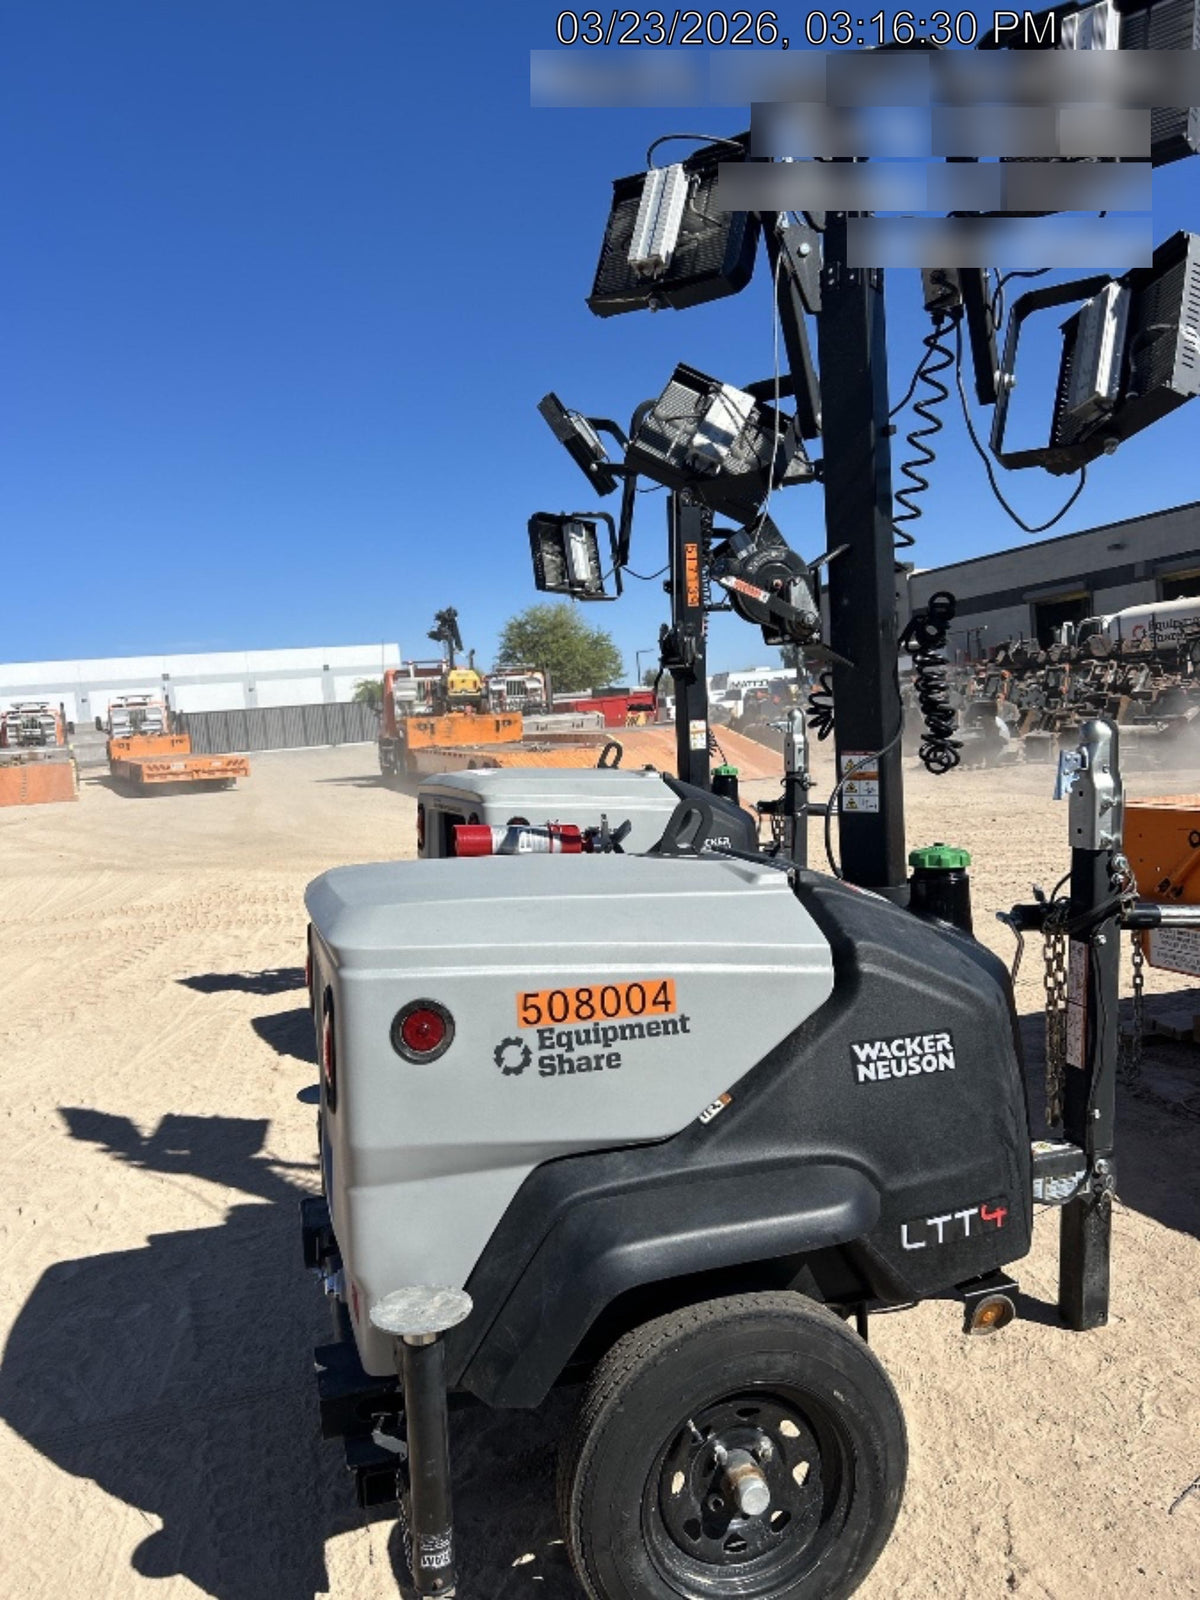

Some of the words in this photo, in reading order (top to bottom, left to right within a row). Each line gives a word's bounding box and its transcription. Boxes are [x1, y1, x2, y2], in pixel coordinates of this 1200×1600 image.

[703, 836, 732, 849] CKER
[521, 981, 672, 1025] 508004
[537, 1013, 690, 1052] Equipment
[851, 1032, 954, 1062] WACKER
[538, 1051, 622, 1078] Share
[856, 1051, 956, 1082] NEUSON
[901, 1204, 1008, 1250] LTT4
